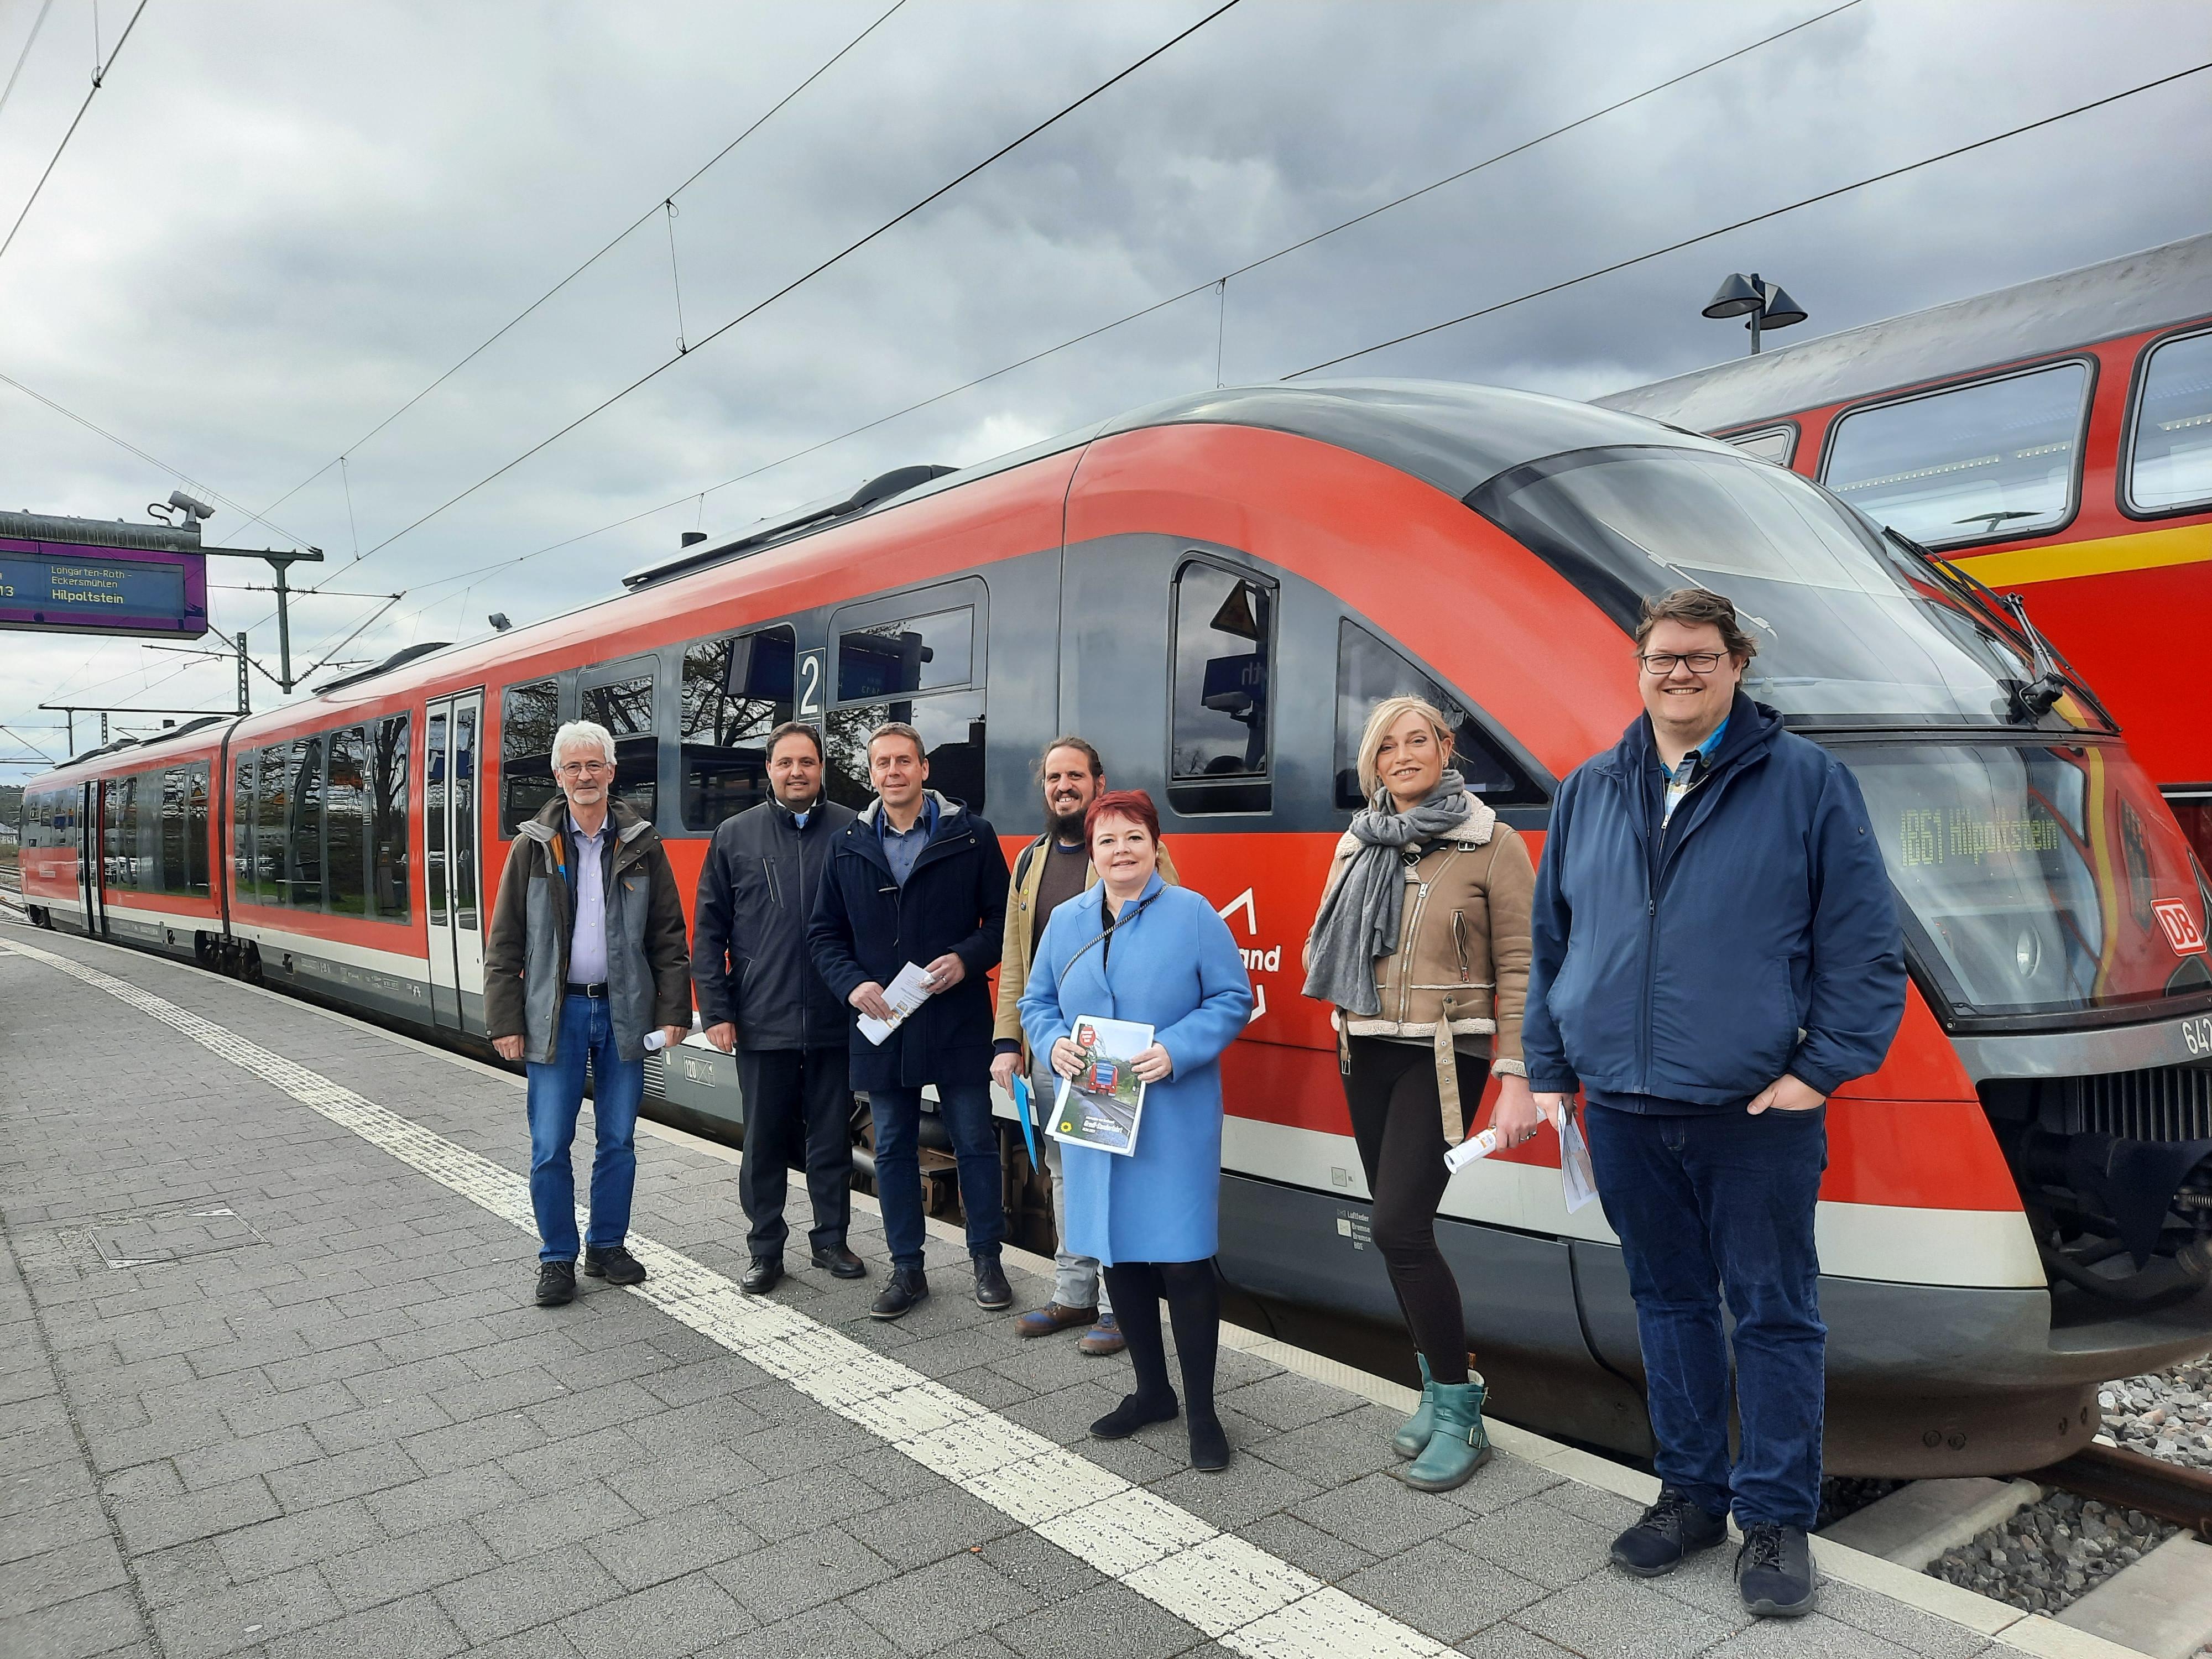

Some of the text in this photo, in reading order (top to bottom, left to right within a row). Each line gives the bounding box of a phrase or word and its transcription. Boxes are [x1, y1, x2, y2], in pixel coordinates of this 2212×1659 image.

[51, 566, 124, 578] Lohgarten-Roth
[51, 576, 118, 588] Eckersmühlen
[52, 589, 124, 603] Hilpoltstein
[800, 655, 818, 714] 2
[364, 744, 371, 776] 2
[2159, 907, 2198, 945] DB
[686, 1059, 697, 1079] 120
